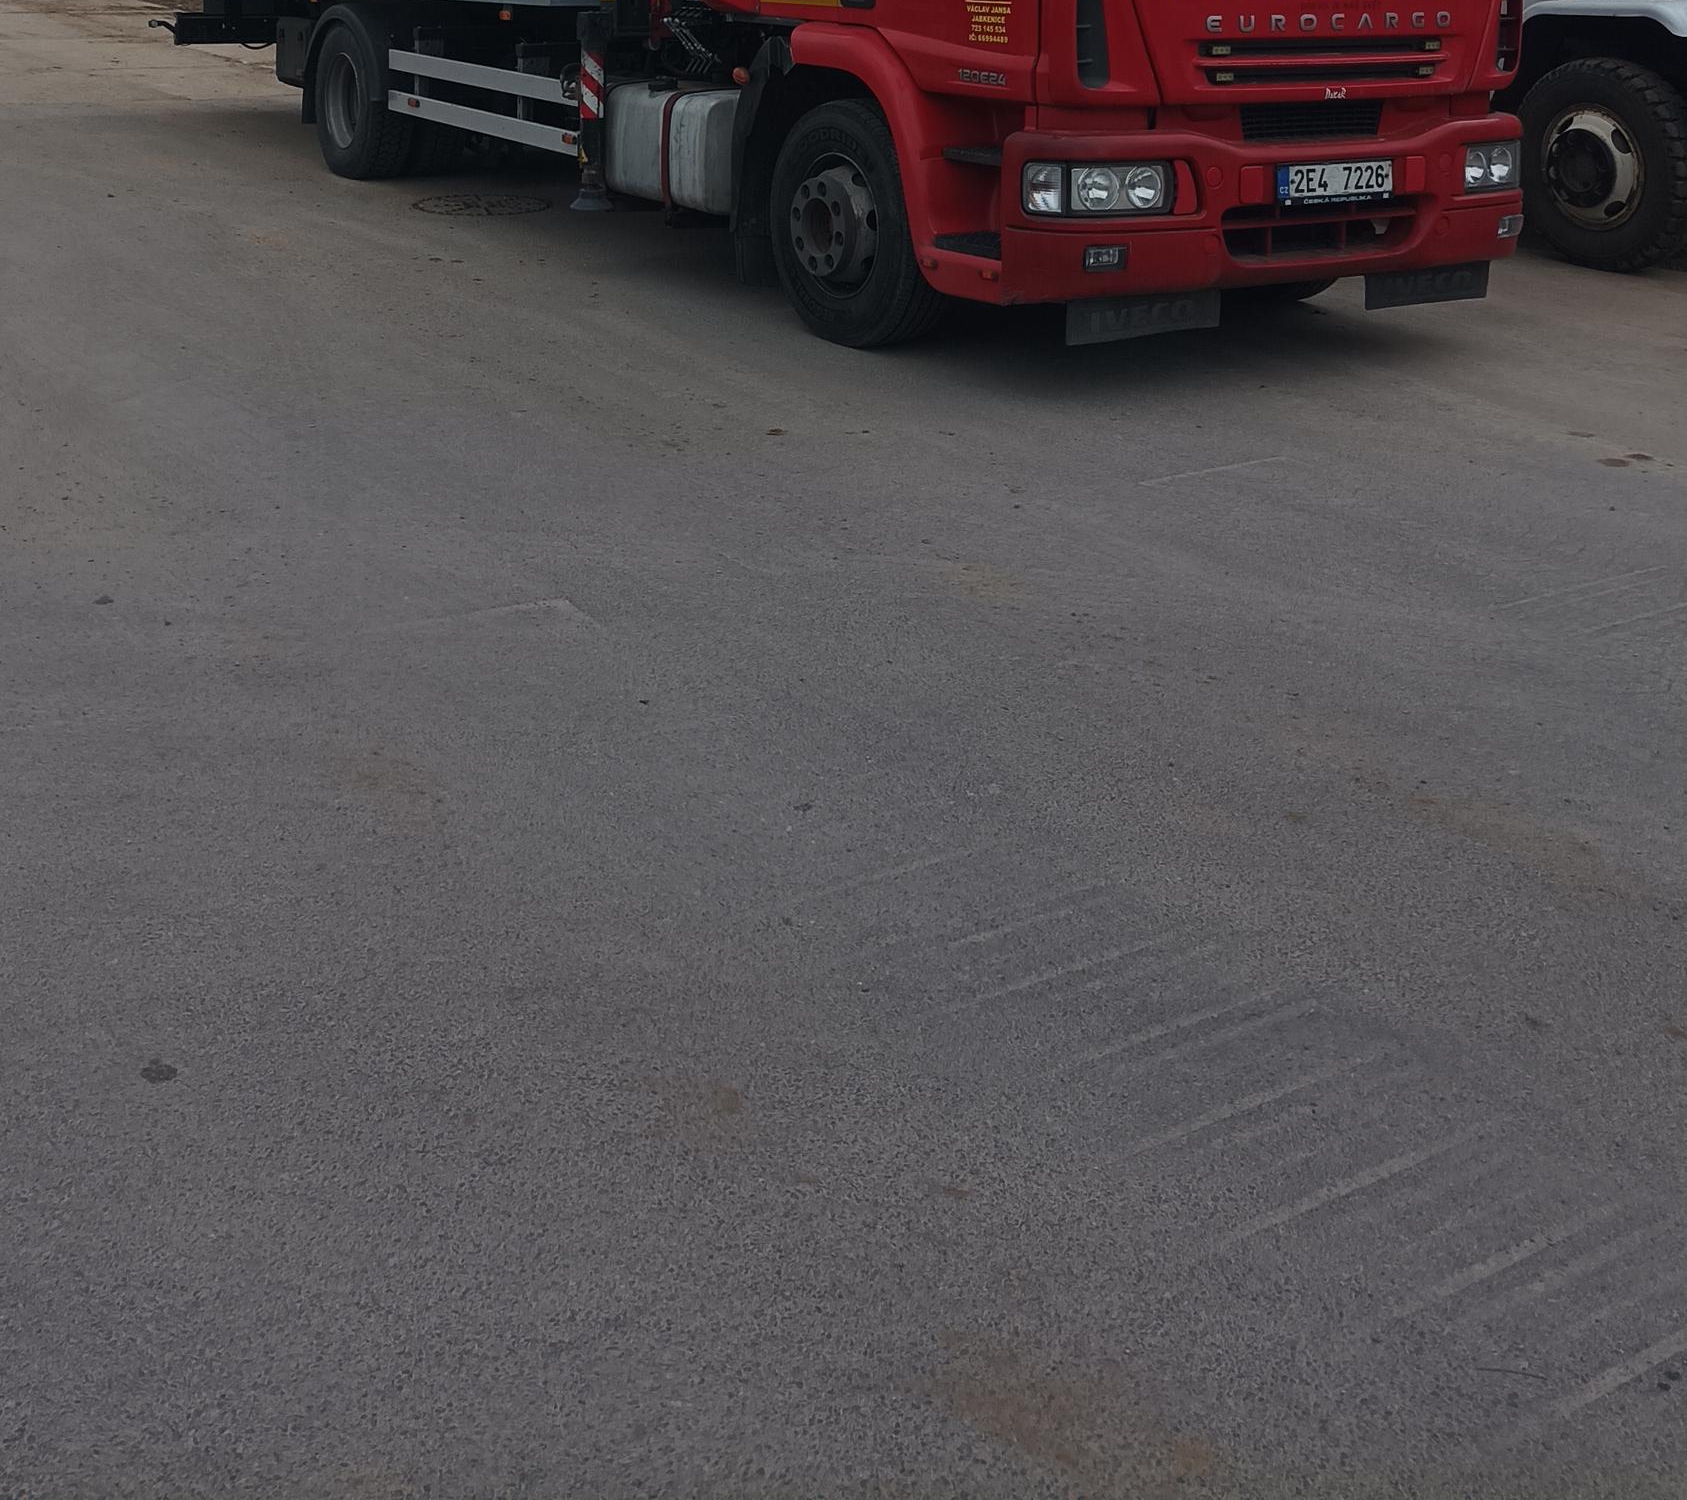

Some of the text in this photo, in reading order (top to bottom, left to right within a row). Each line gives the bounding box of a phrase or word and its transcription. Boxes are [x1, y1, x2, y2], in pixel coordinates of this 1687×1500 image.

[1205, 11, 1452, 34] EUROCARGO
[1279, 185, 1289, 194] CZ
[1293, 164, 1386, 194] 2E4 7226
